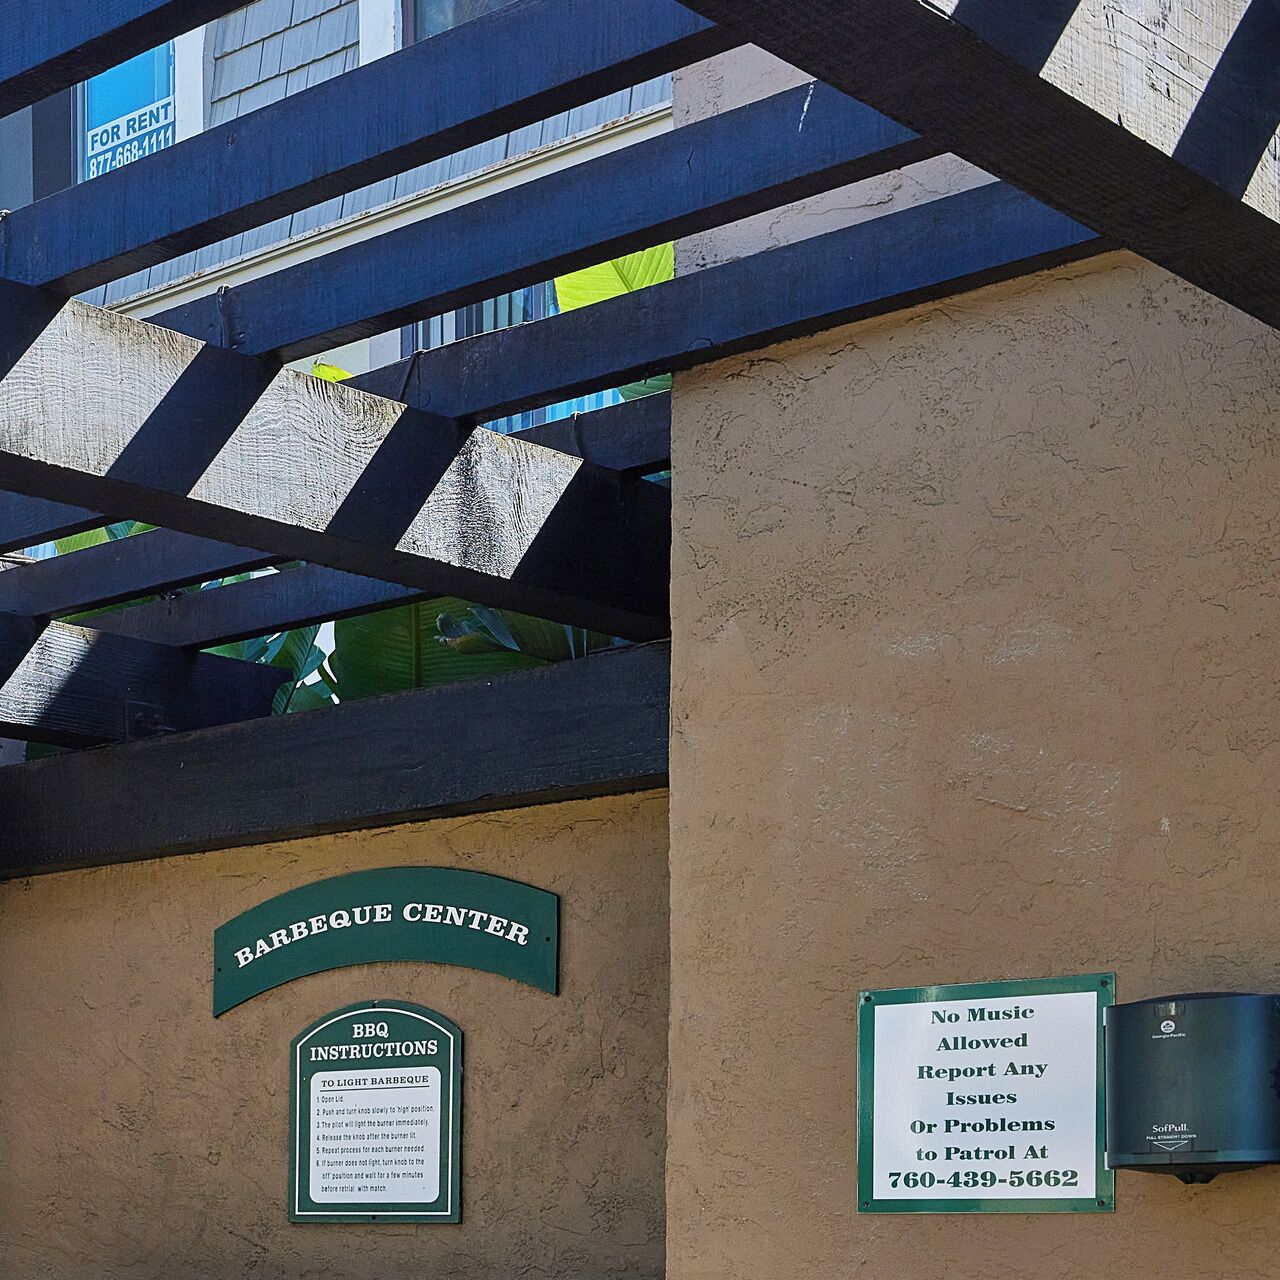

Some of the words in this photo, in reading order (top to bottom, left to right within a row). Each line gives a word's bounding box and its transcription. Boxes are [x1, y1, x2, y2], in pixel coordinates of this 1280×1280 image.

[90, 125, 120, 151] FOR
[126, 102, 172, 136] RENT
[90, 126, 173, 179] 877-668-1111
[233, 903, 393, 969] BARBEQUE
[402, 902, 530, 946] CENTER
[931, 1009, 960, 1025] No
[967, 1006, 1035, 1023] Music
[352, 1022, 389, 1039] BBQ
[309, 1040, 438, 1061] INSTRUCTIONS
[936, 1033, 1028, 1052] Allowed
[337, 1078, 368, 1087] LIGHT
[371, 1075, 429, 1085] BARBEQUE
[917, 1064, 996, 1081] Report
[1003, 1062, 1048, 1080] Any
[946, 1092, 1017, 1106] Issues
[332, 1121, 343, 1129] pilot
[910, 1119, 938, 1134] Or
[943, 1117, 1056, 1134] Problems
[916, 1147, 937, 1162] to
[944, 1145, 1016, 1161] Patrol
[1023, 1145, 1049, 1160] At
[887, 1170, 1079, 1189] 760-439-5662
